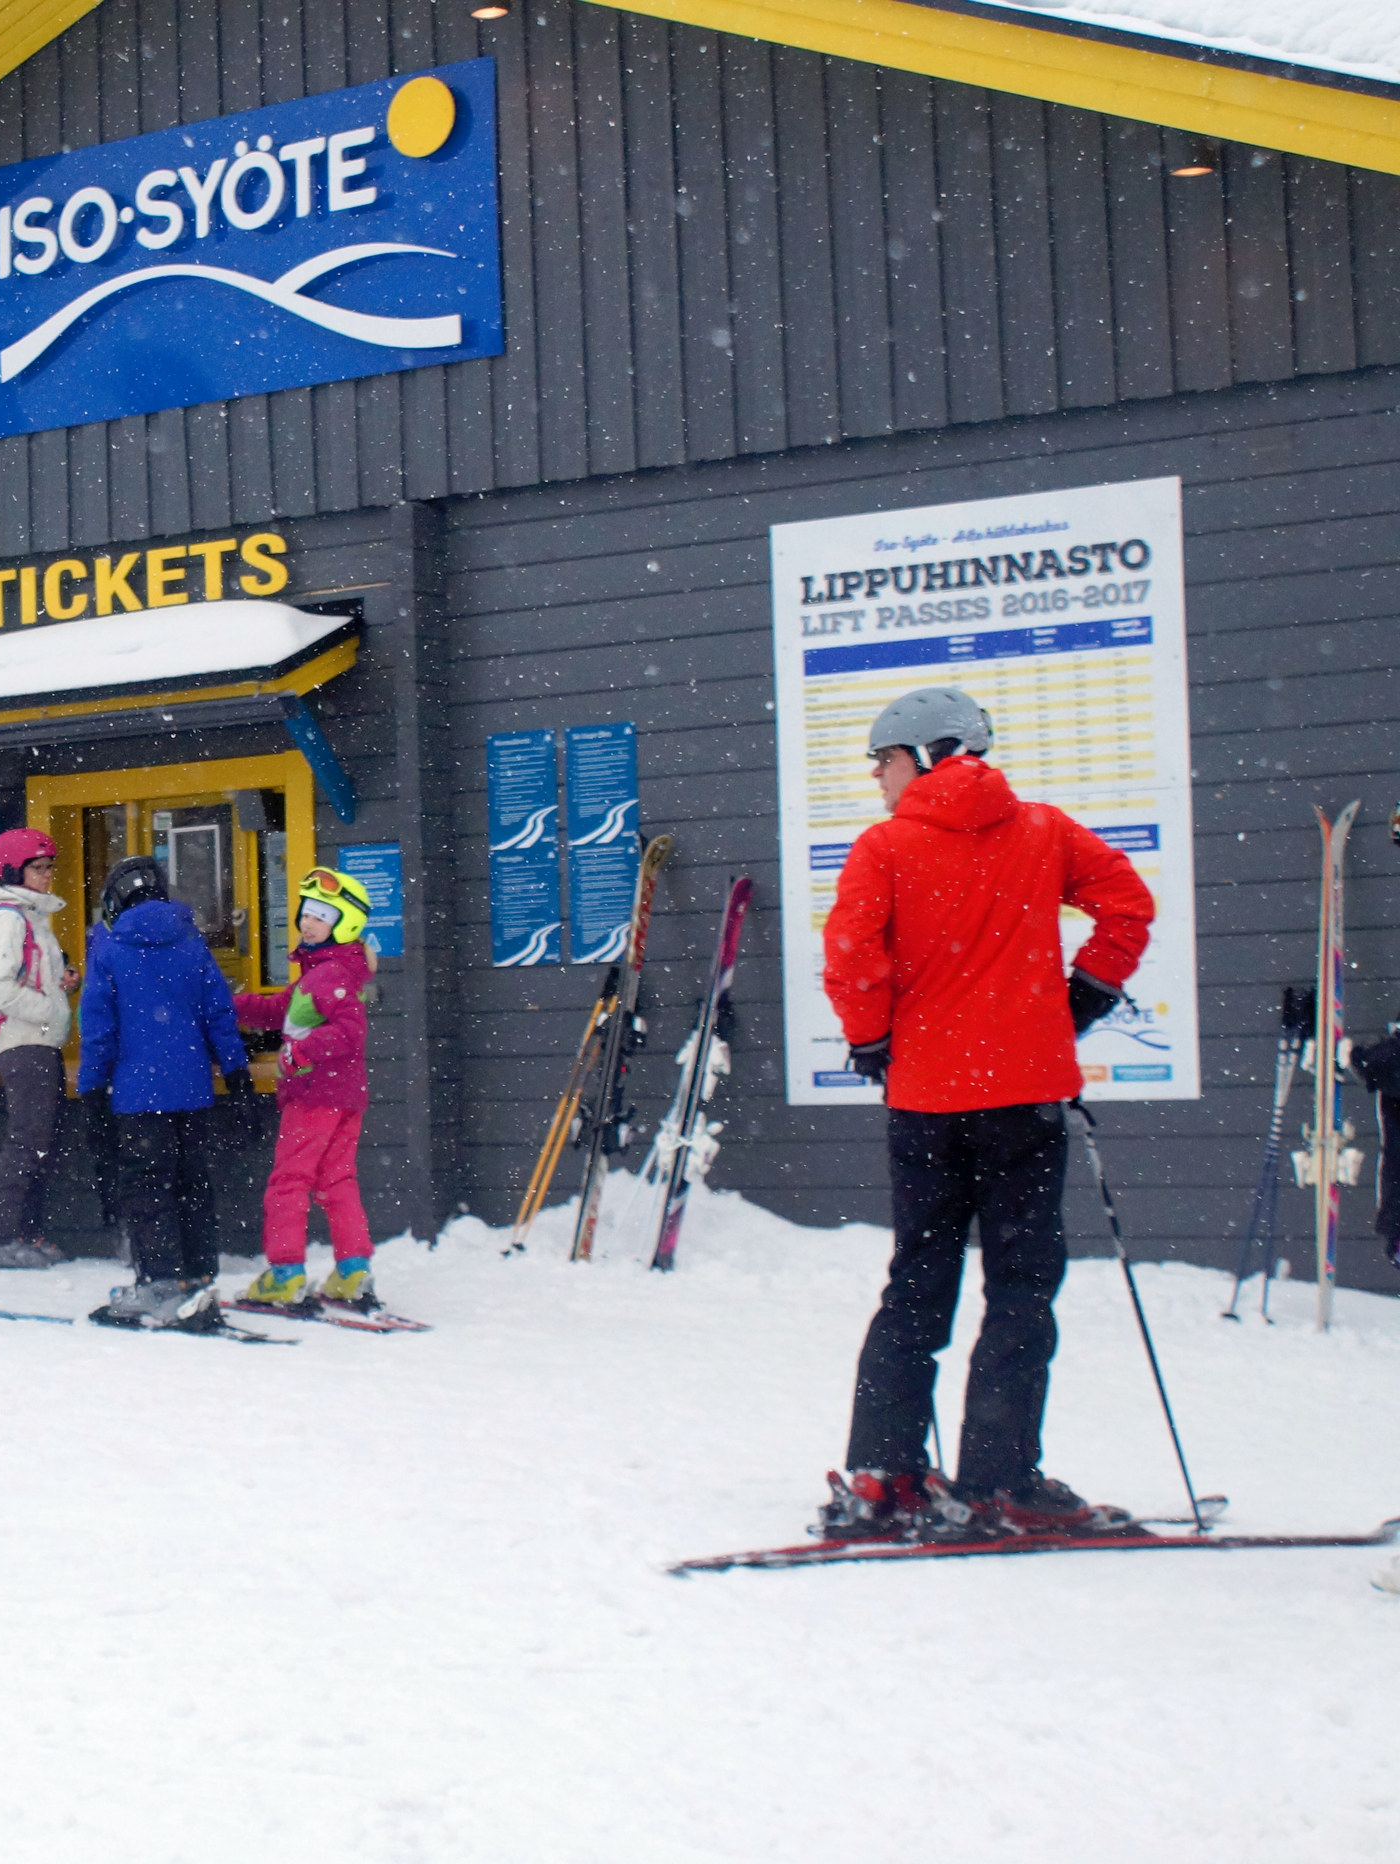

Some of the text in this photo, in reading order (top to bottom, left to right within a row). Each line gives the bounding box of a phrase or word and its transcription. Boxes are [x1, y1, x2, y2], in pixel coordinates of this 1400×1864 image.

[800, 538, 1152, 606] LIPPUHINNASTO
[800, 579, 1152, 638] LIFT PASSES 2016-2017
